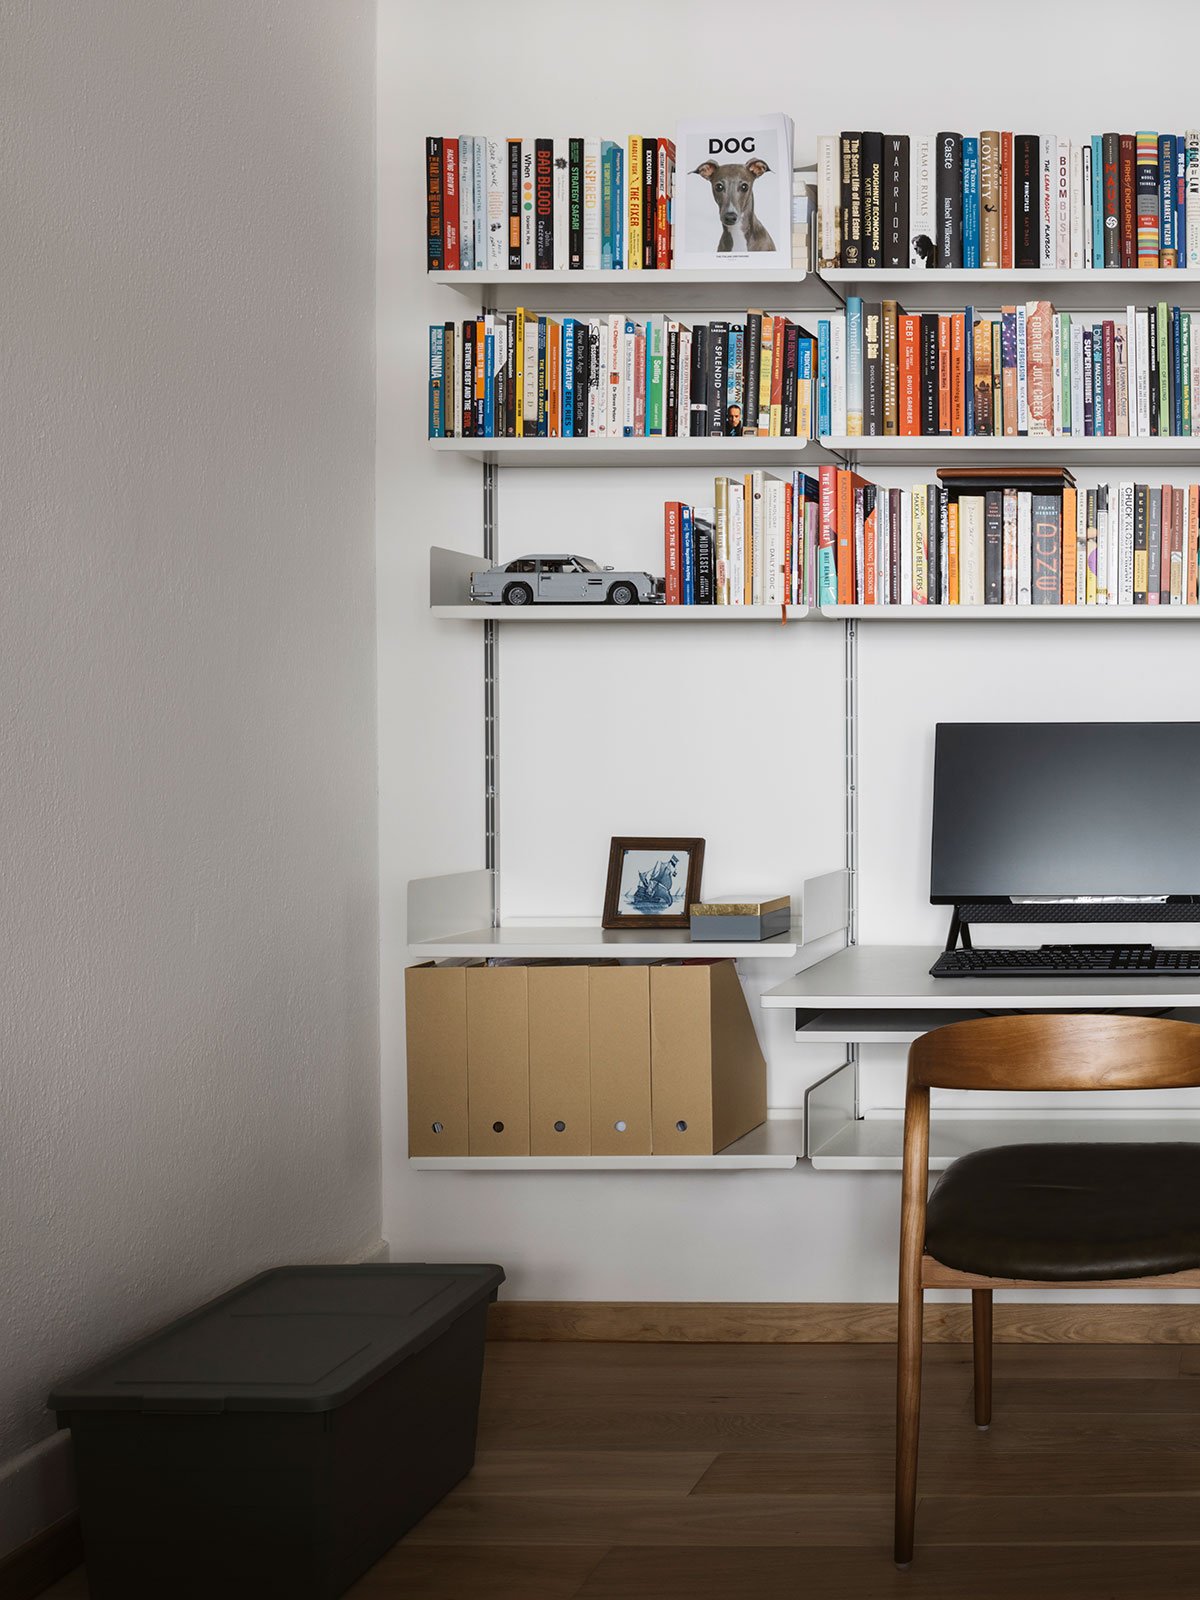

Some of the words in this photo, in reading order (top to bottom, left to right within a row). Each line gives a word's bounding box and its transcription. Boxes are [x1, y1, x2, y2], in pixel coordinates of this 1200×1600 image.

[709, 137, 756, 154] DOG
[851, 140, 859, 153] The
[920, 141, 928, 166] TEAM
[944, 138, 954, 169] Caste
[447, 149, 455, 171] HACKING
[538, 151, 550, 174] BAD
[851, 154, 859, 177] Secret
[981, 136, 991, 200] LOYALTY
[571, 167, 579, 202] STRATEGY
[585, 156, 596, 208] INSPIRED
[851, 178, 859, 192] Life
[920, 169, 927, 182] OF
[993, 180, 998, 189] OF
[538, 176, 550, 214] BLOOD
[630, 187, 638, 202] THE
[892, 141, 900, 243] WARRIOR
[1105, 162, 1116, 215] MAUS
[920, 185, 928, 216] RIVALS
[944, 197, 952, 219] Isabel
[630, 204, 639, 227] FIXER
[852, 218, 860, 240] Estate
[944, 220, 952, 257] Wilkerson
[866, 315, 879, 343] Shuggie
[905, 320, 913, 342] DEBT
[1032, 316, 1041, 349] FOURTH
[1093, 329, 1101, 352] blink
[850, 313, 860, 375] Nomadland
[868, 344, 878, 359] Bain
[431, 355, 442, 379] NINJA
[575, 361, 583, 373] Age
[714, 346, 722, 389] SPLENDID
[1032, 352, 1041, 363] OF
[1073, 342, 1081, 374] Intelligence
[652, 360, 660, 384] Selling
[1032, 366, 1041, 387] JULY
[1033, 389, 1041, 417] CREEK
[713, 409, 721, 427] VILE
[699, 536, 708, 574] MIDDLESEX
